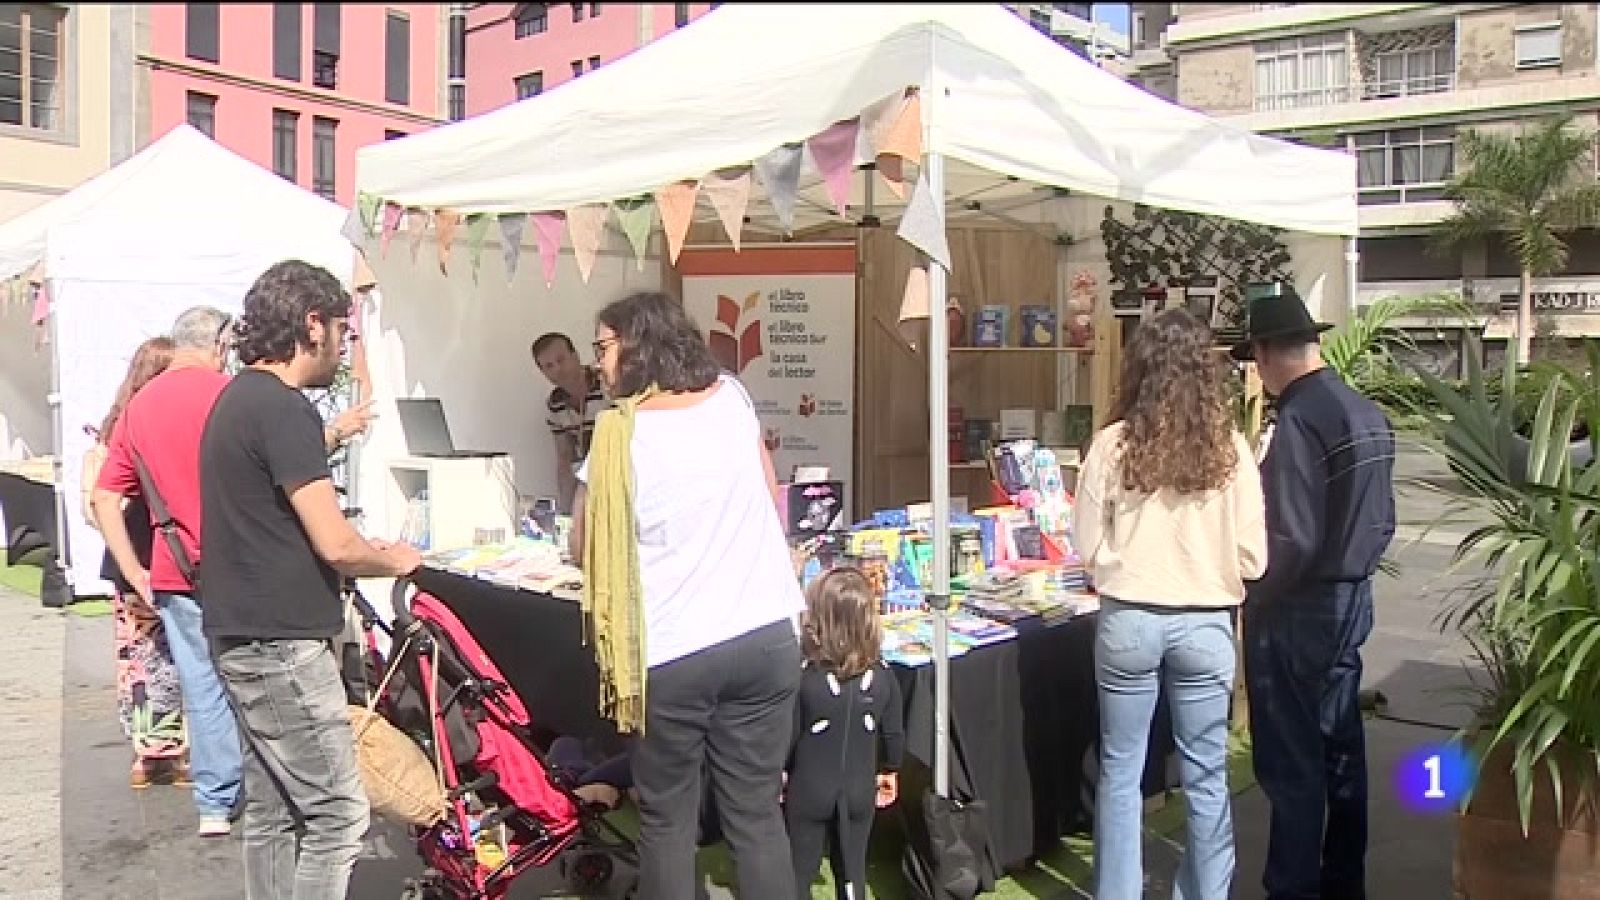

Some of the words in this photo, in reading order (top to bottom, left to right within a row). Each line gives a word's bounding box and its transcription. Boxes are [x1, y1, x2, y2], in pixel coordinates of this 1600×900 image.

[780, 289, 806, 301] libro
[780, 319, 806, 333] libro
[782, 353, 807, 363] casa
[784, 366, 816, 378] lector
